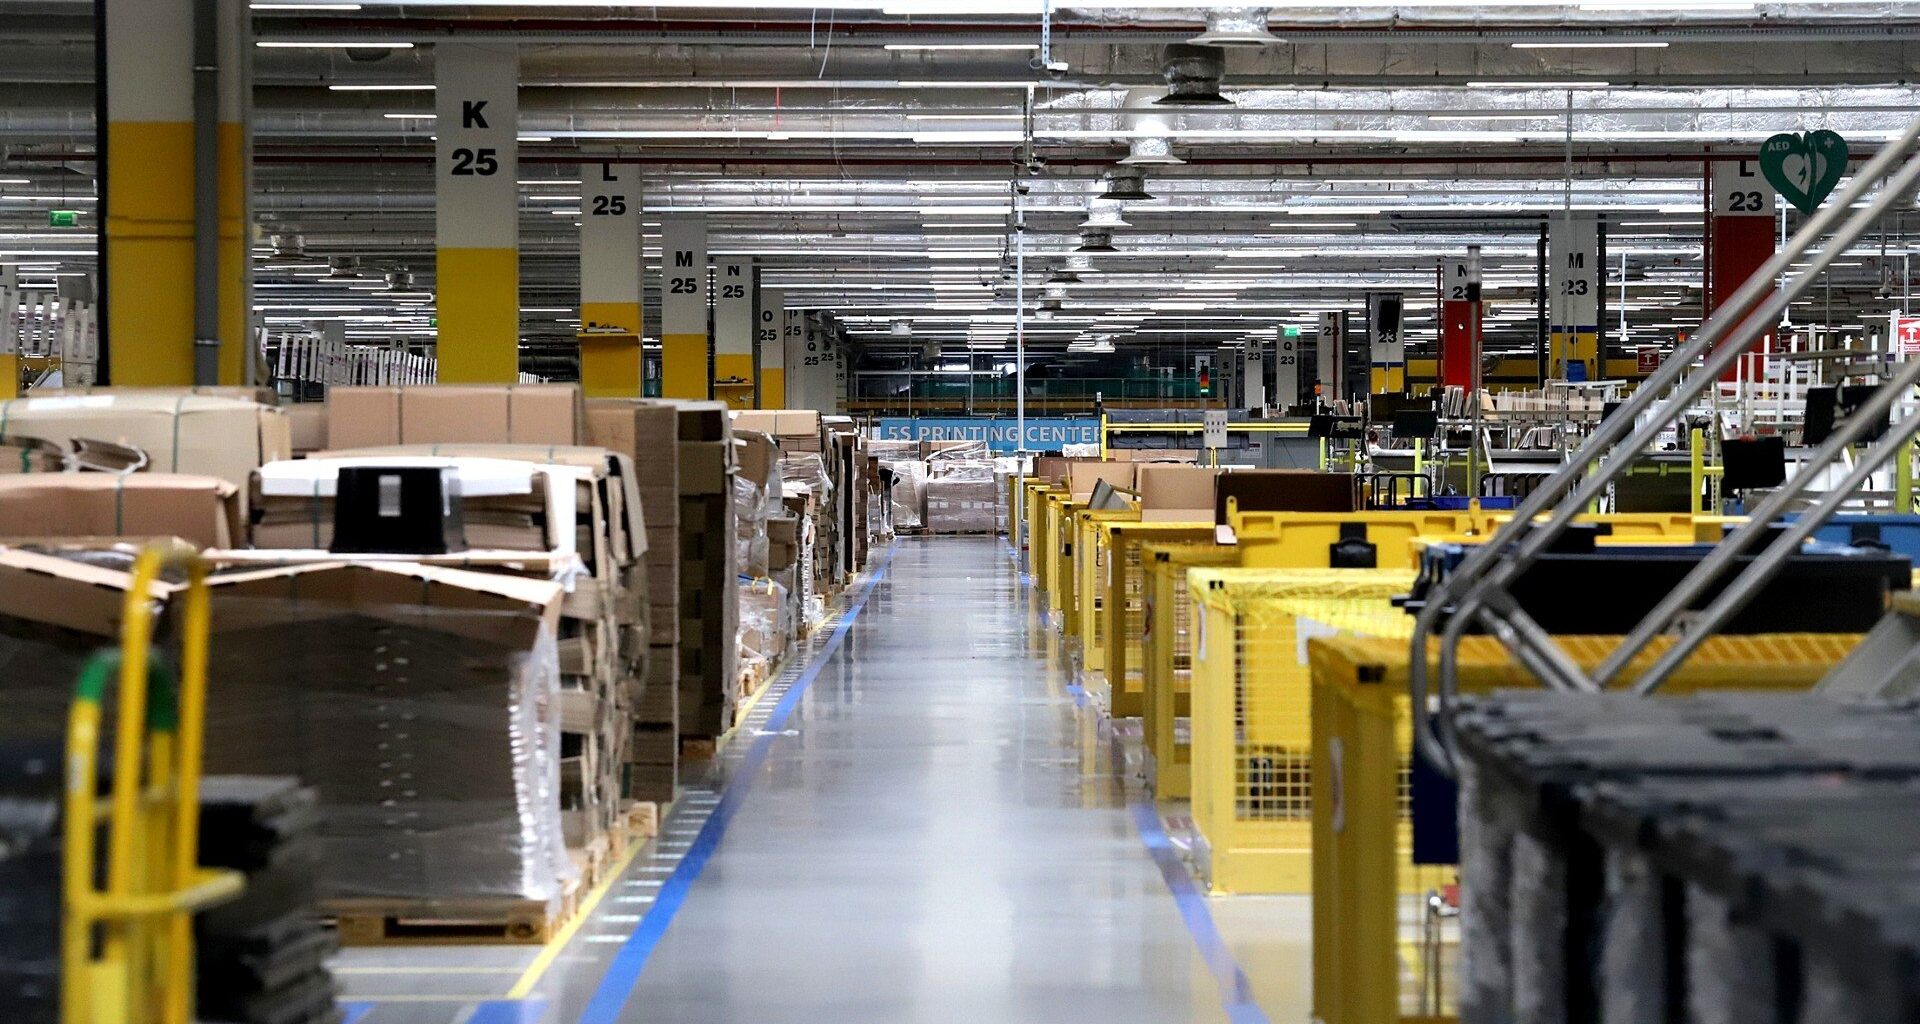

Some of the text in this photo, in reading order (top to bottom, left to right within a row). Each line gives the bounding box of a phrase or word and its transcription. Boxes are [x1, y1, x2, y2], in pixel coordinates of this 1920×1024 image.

[463, 101, 489, 128] K
[1768, 141, 1790, 152] AED
[451, 148, 498, 176] 25
[602, 162, 618, 181] L
[1740, 160, 1755, 177] L
[592, 195, 627, 215] 25
[1728, 191, 1763, 212] 23
[676, 251, 693, 267] M
[1568, 252, 1584, 269] M
[727, 265, 740, 277] N
[670, 278, 698, 294] 25
[722, 285, 745, 299] 25
[1561, 279, 1588, 296] 23
[760, 329, 777, 341] 25
[785, 325, 801, 336] 25
[1869, 325, 1884, 335] 21
[1378, 331, 1398, 343] 23
[395, 340, 404, 348] R
[807, 342, 817, 351] Q
[1283, 342, 1293, 351] Q
[804, 356, 819, 366] 25
[821, 353, 834, 361] 25
[1248, 352, 1261, 361] 23
[1280, 356, 1295, 365] 23
[888, 426, 911, 440] 5S
[919, 426, 1018, 442] PRINTING
